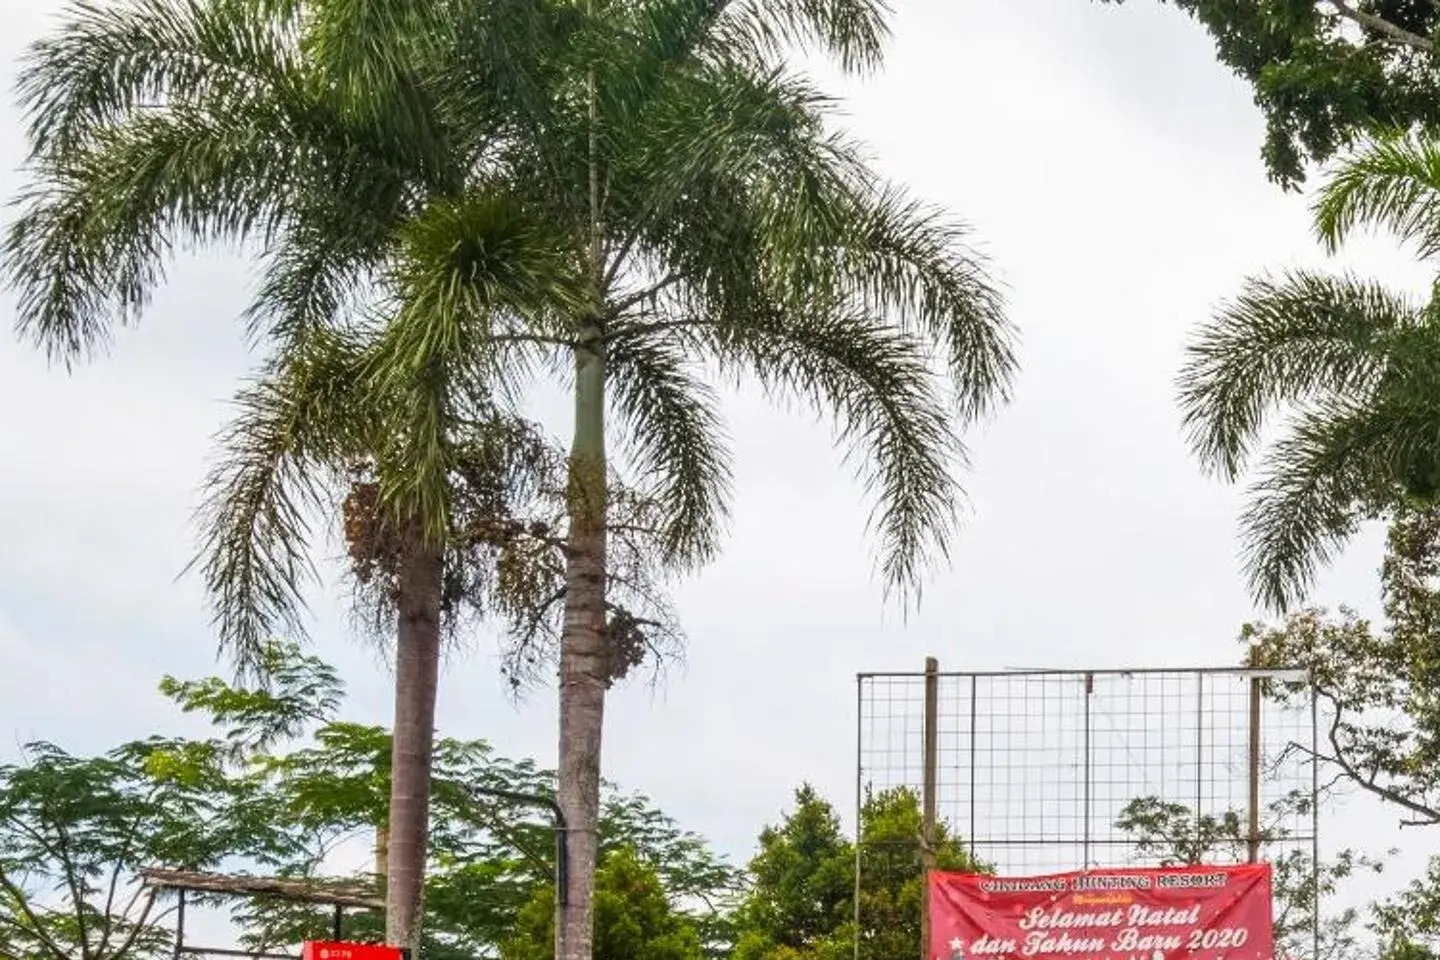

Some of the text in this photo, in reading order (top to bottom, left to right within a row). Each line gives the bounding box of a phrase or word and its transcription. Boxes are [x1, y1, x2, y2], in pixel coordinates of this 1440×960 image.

[1072, 875, 1150, 890] HUNTING
[1156, 873, 1226, 888] RESORT
[1019, 903, 1200, 929] Selamat Natal
[970, 927, 1249, 956] dan Tahun Baru 2020
